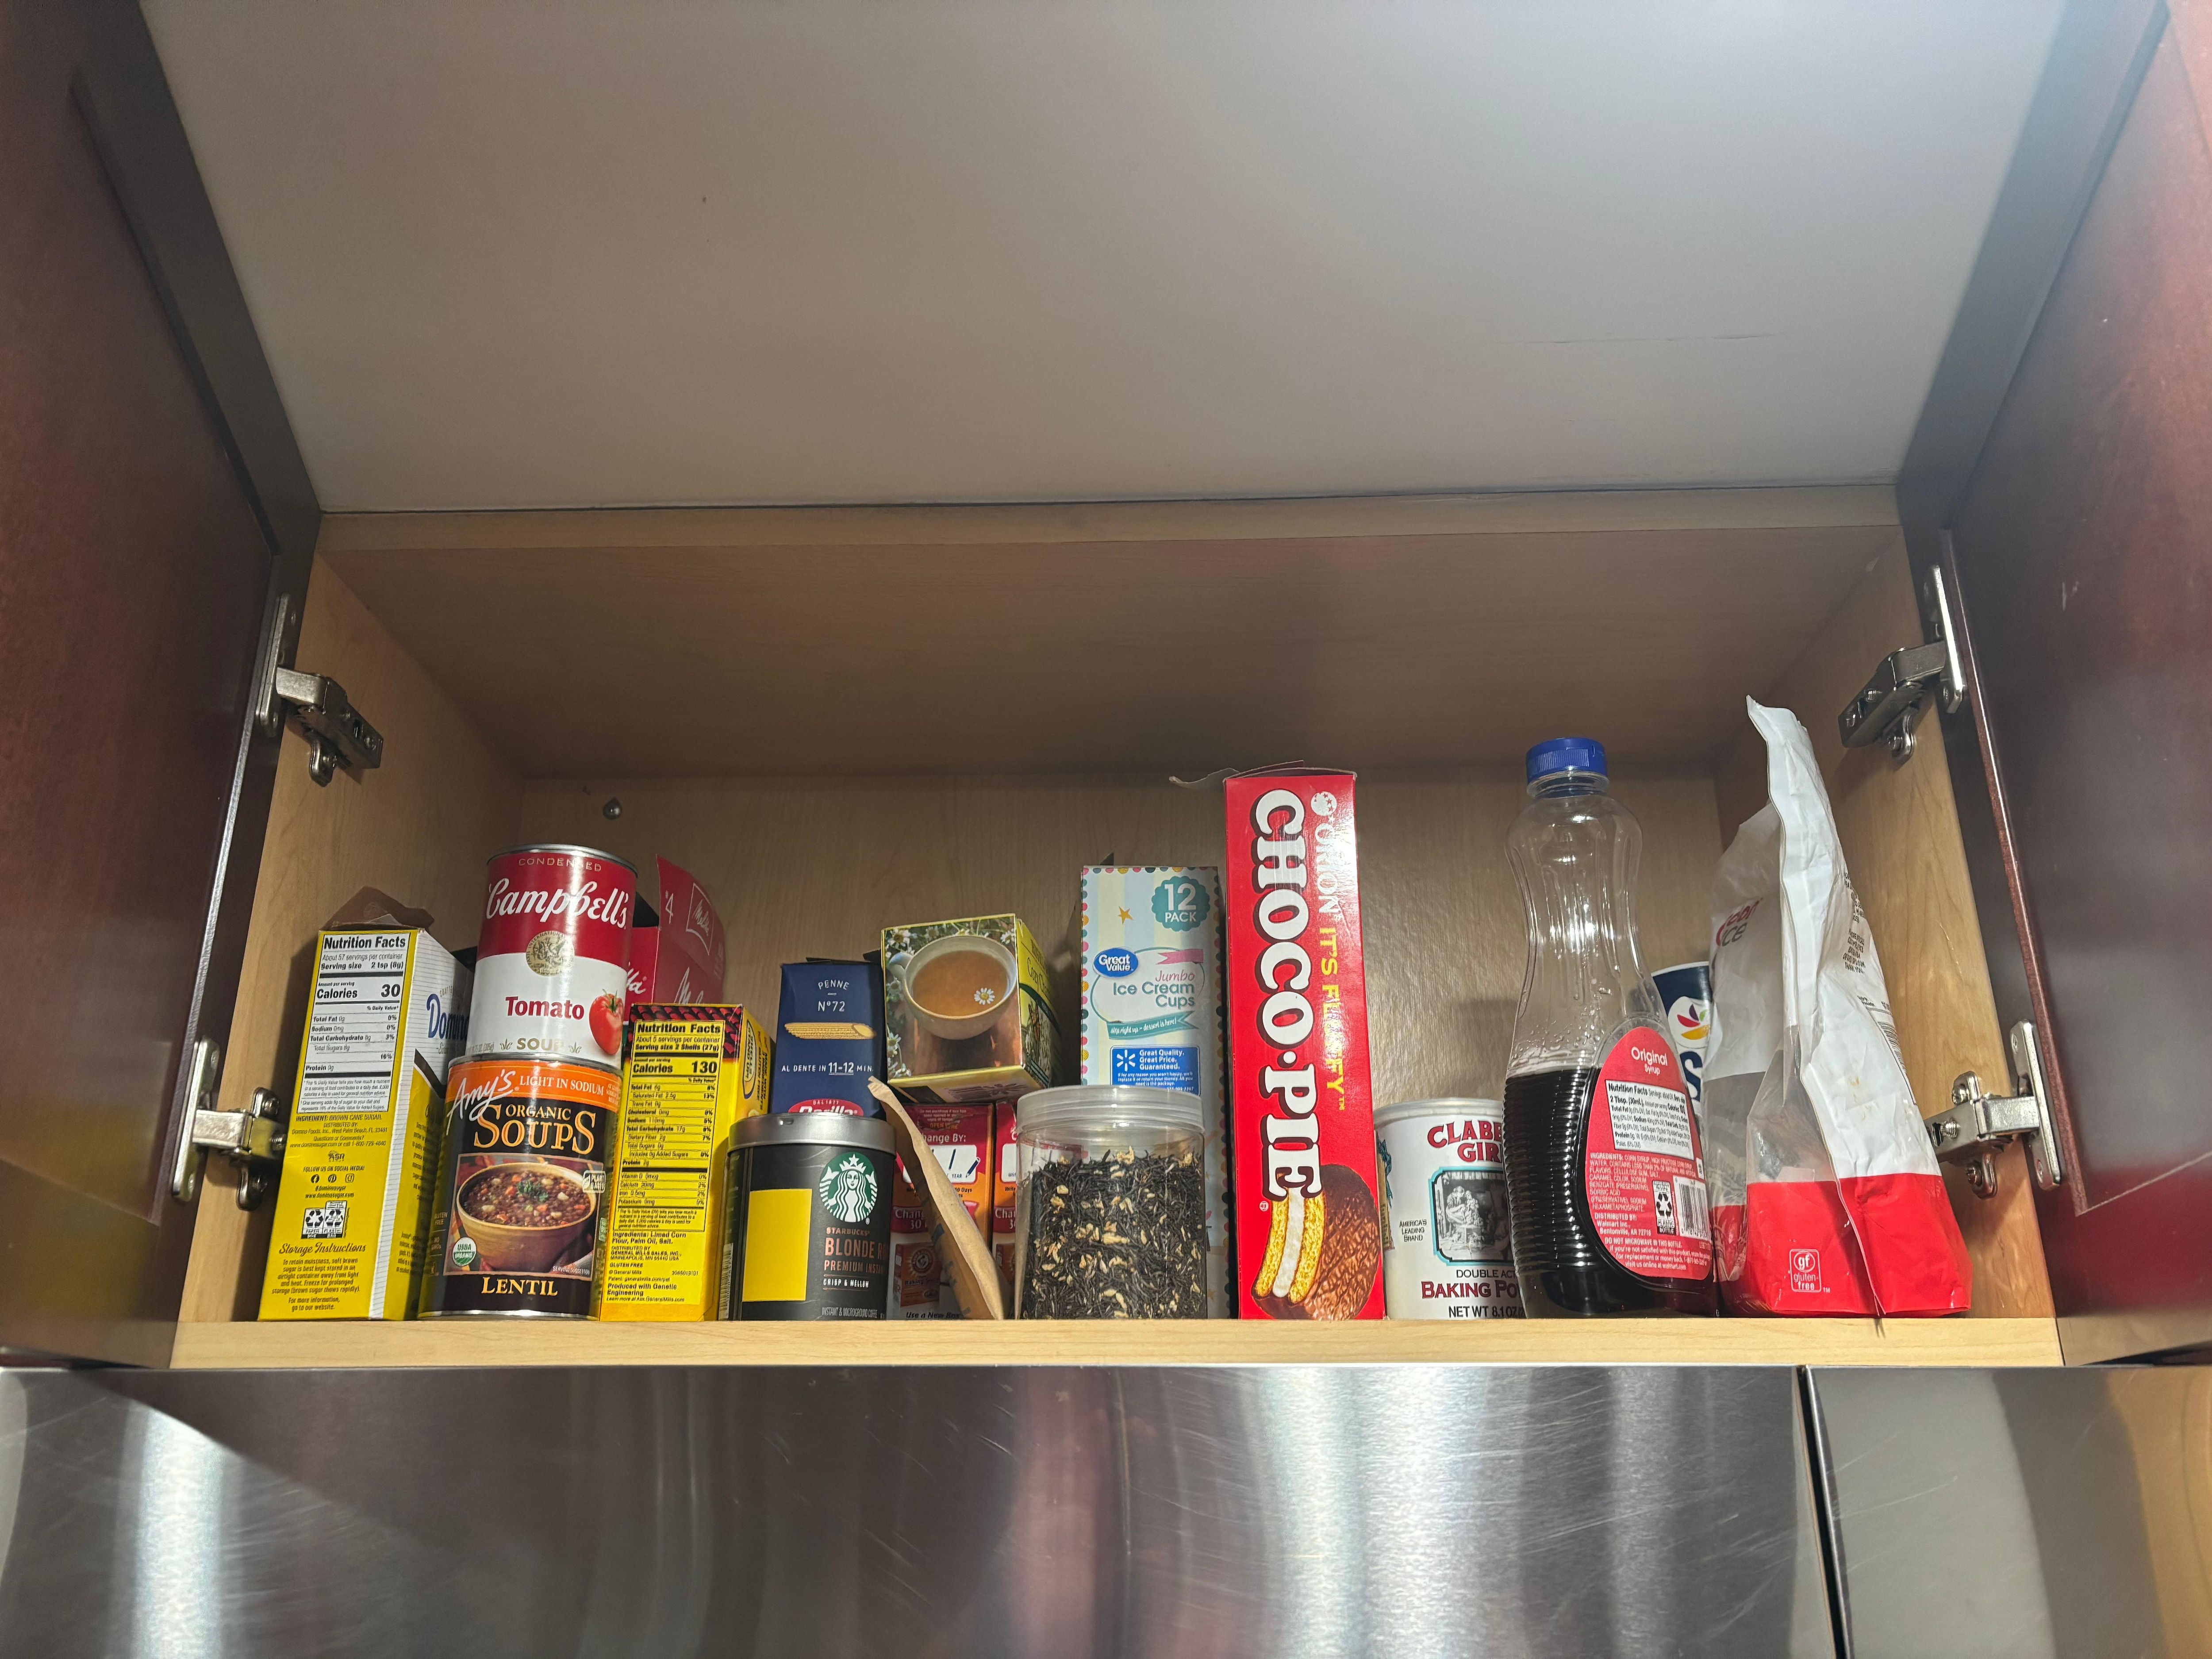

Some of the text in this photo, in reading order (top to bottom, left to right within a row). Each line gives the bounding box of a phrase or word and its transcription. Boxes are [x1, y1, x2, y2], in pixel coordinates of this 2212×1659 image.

[486, 878, 630, 929] Campbell's
[1164, 883, 1197, 911] 12
[1165, 912, 1197, 922] PACK
[324, 936, 406, 949] Nutrition Facts
[1319, 928, 1338, 975] IT'S
[1099, 954, 1130, 966] Great
[1106, 963, 1131, 972] Value
[1156, 970, 1195, 983] Jumbo
[317, 983, 400, 999] Calories 30
[818, 980, 849, 990] PENNE
[1113, 982, 1194, 995] Ice Cream
[1156, 995, 1195, 1007] Cups
[505, 996, 584, 1020] Tomato
[637, 1023, 720, 1033] Nutrition Facts
[516, 1037, 565, 1051] SOUP
[1631, 1046, 1668, 1067] Original
[633, 1061, 717, 1073] Calories 130
[829, 1062, 854, 1073] 11-12
[1644, 1064, 1660, 1075] Syrup
[519, 1075, 554, 1087] LIGHT
[557, 1078, 568, 1088] IN
[570, 1079, 604, 1096] SODIUM
[1608, 1083, 1648, 1095] Nutrition Facts
[446, 1069, 516, 1136] Amy's
[506, 1104, 571, 1121] ORGANIC
[474, 1104, 596, 1155] SOUPS
[952, 1133, 966, 1142] BY:
[1399, 1219, 1427, 1228] AMERICA'S
[826, 1227, 870, 1236] STARBUCKS
[279, 1242, 366, 1256] Storage Instructions
[825, 1237, 875, 1259] BLONDE
[824, 1260, 863, 1272] PREMIUM
[1799, 1255, 1810, 1270] gf
[1456, 1269, 1517, 1278] DOUBLE ACT
[481, 1276, 558, 1296] LENTIL
[1421, 1281, 1491, 1299] BAKING
[1798, 1282, 1815, 1291] free
[822, 1307, 839, 1316] INSTANT
[1448, 1306, 1472, 1318] NET
[1473, 1306, 1489, 1317] WT
